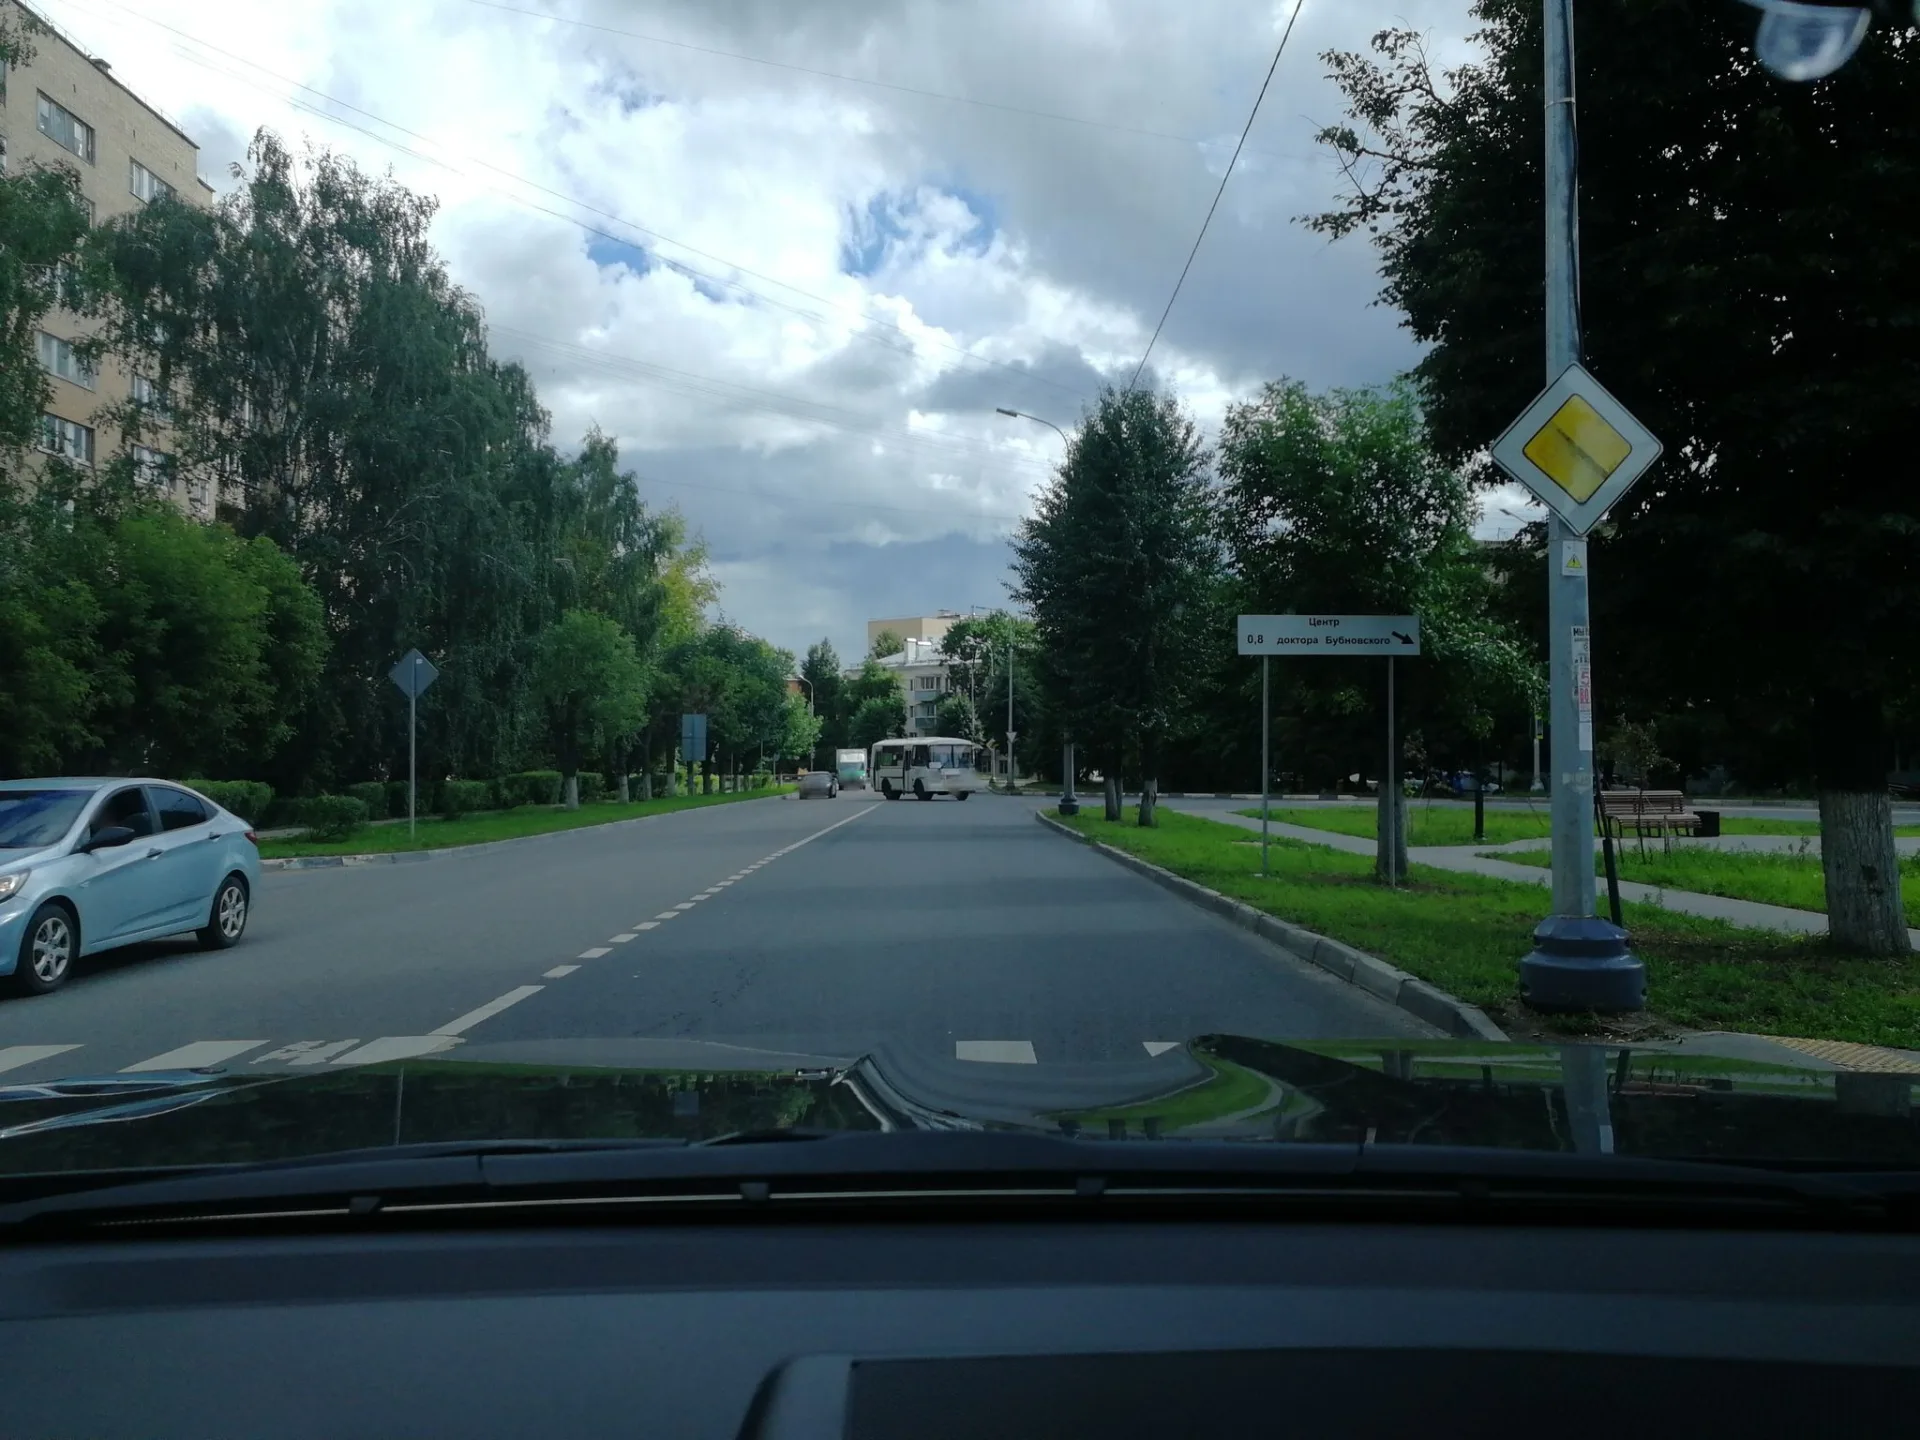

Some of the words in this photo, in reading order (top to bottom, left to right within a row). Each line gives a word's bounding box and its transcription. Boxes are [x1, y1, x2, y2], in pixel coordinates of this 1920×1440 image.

[1308, 617, 1340, 627] Центр
[1247, 634, 1264, 645] 0,8
[1276, 636, 1319, 646] доктора
[1325, 635, 1391, 646] Бубновского
